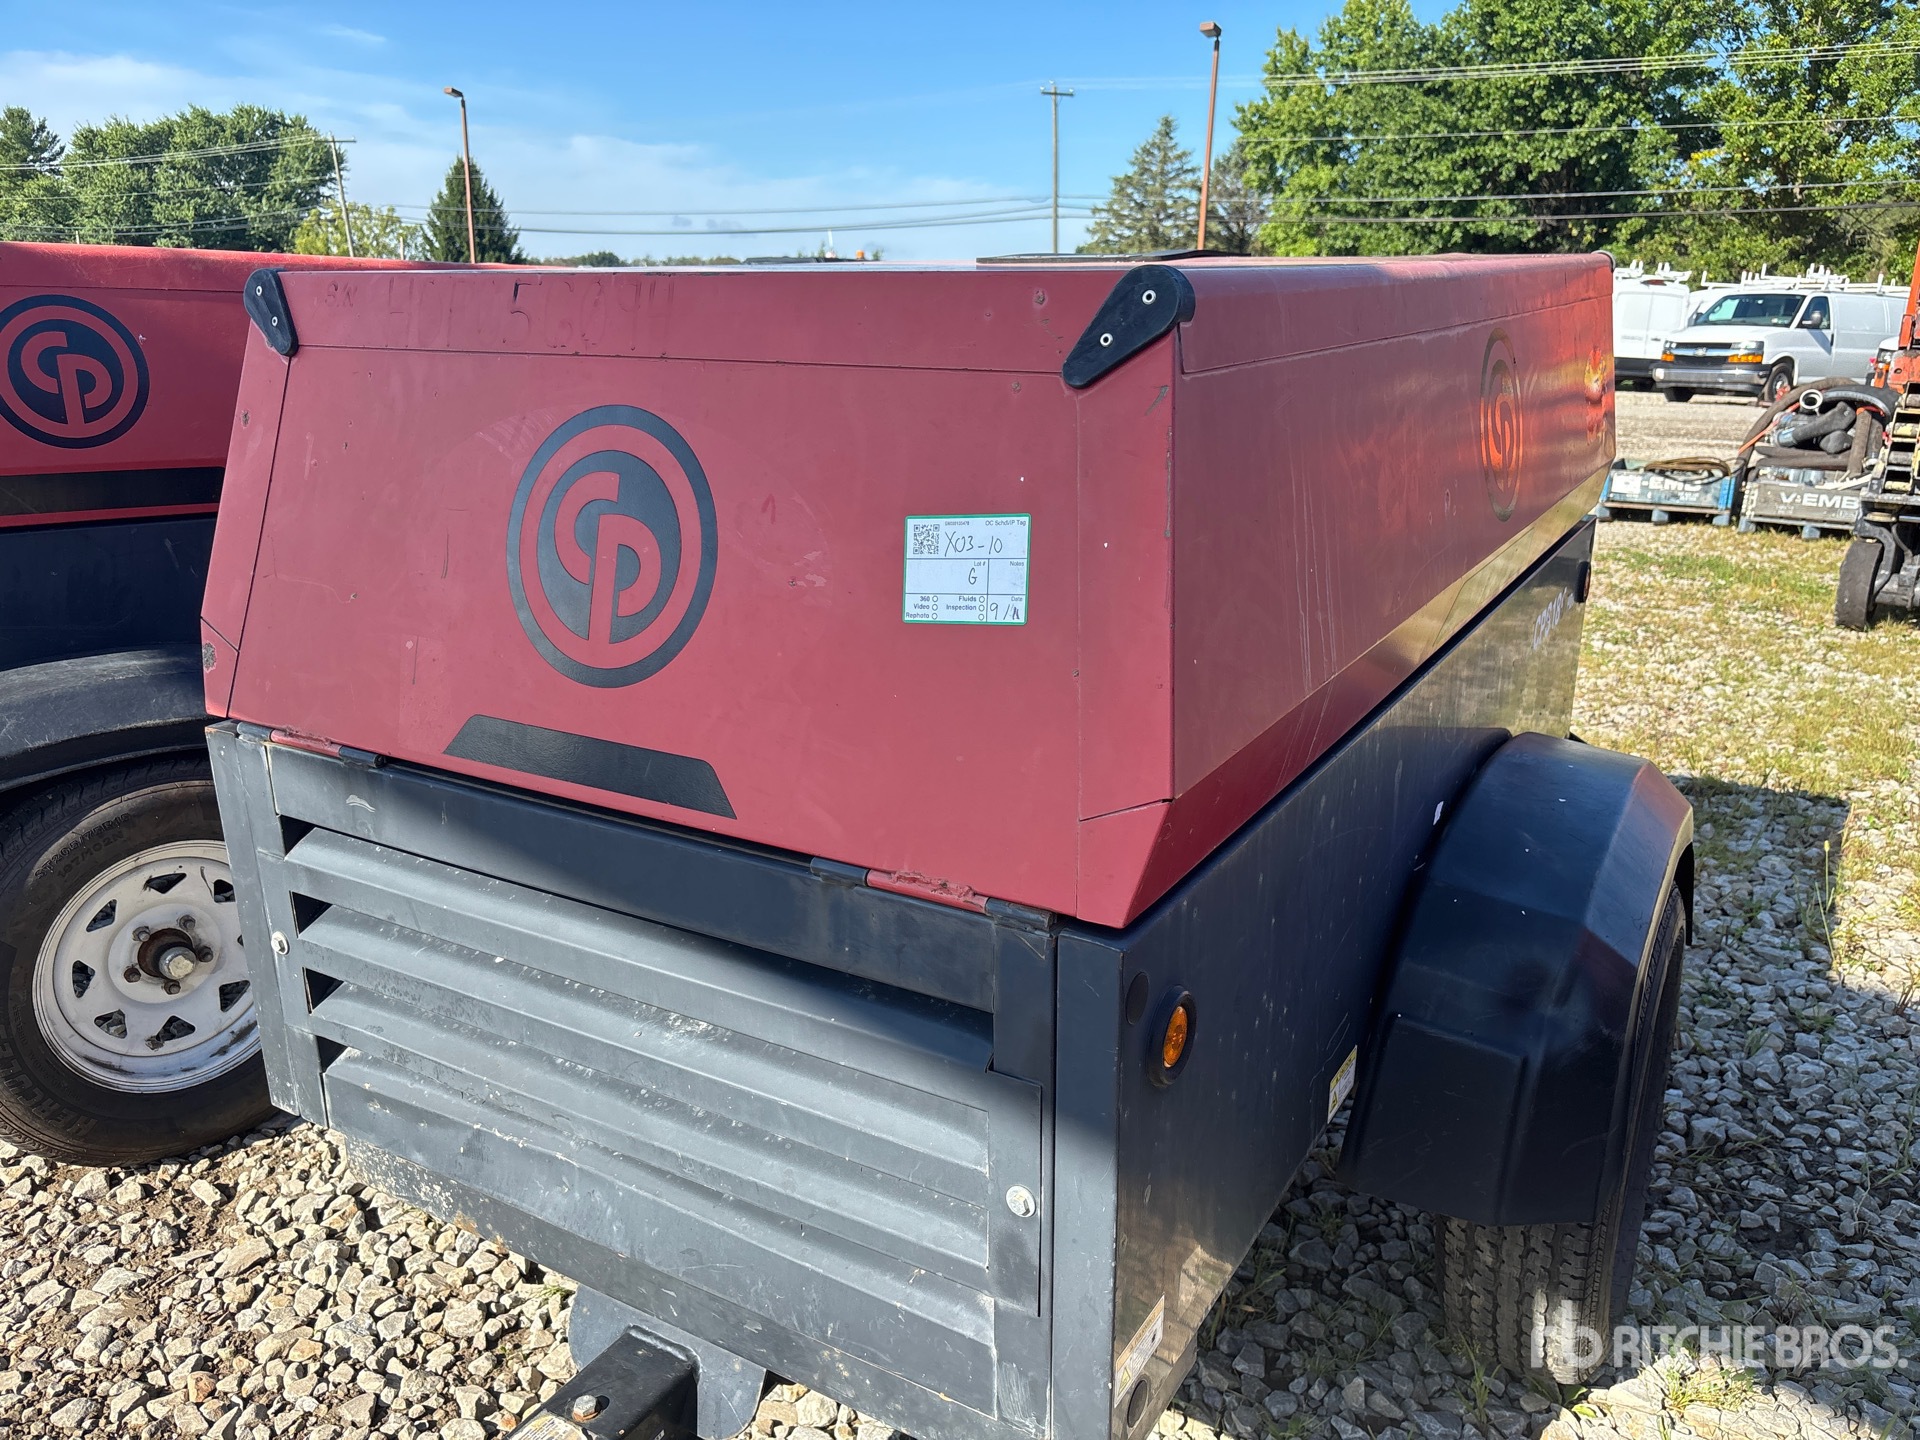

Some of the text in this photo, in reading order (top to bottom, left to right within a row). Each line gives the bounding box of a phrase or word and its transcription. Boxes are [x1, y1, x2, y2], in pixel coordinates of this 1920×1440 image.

[968, 567, 978, 585] G
[913, 603, 930, 611] Video
[945, 604, 977, 612] Inspection
[905, 612, 930, 620] Rephoto
